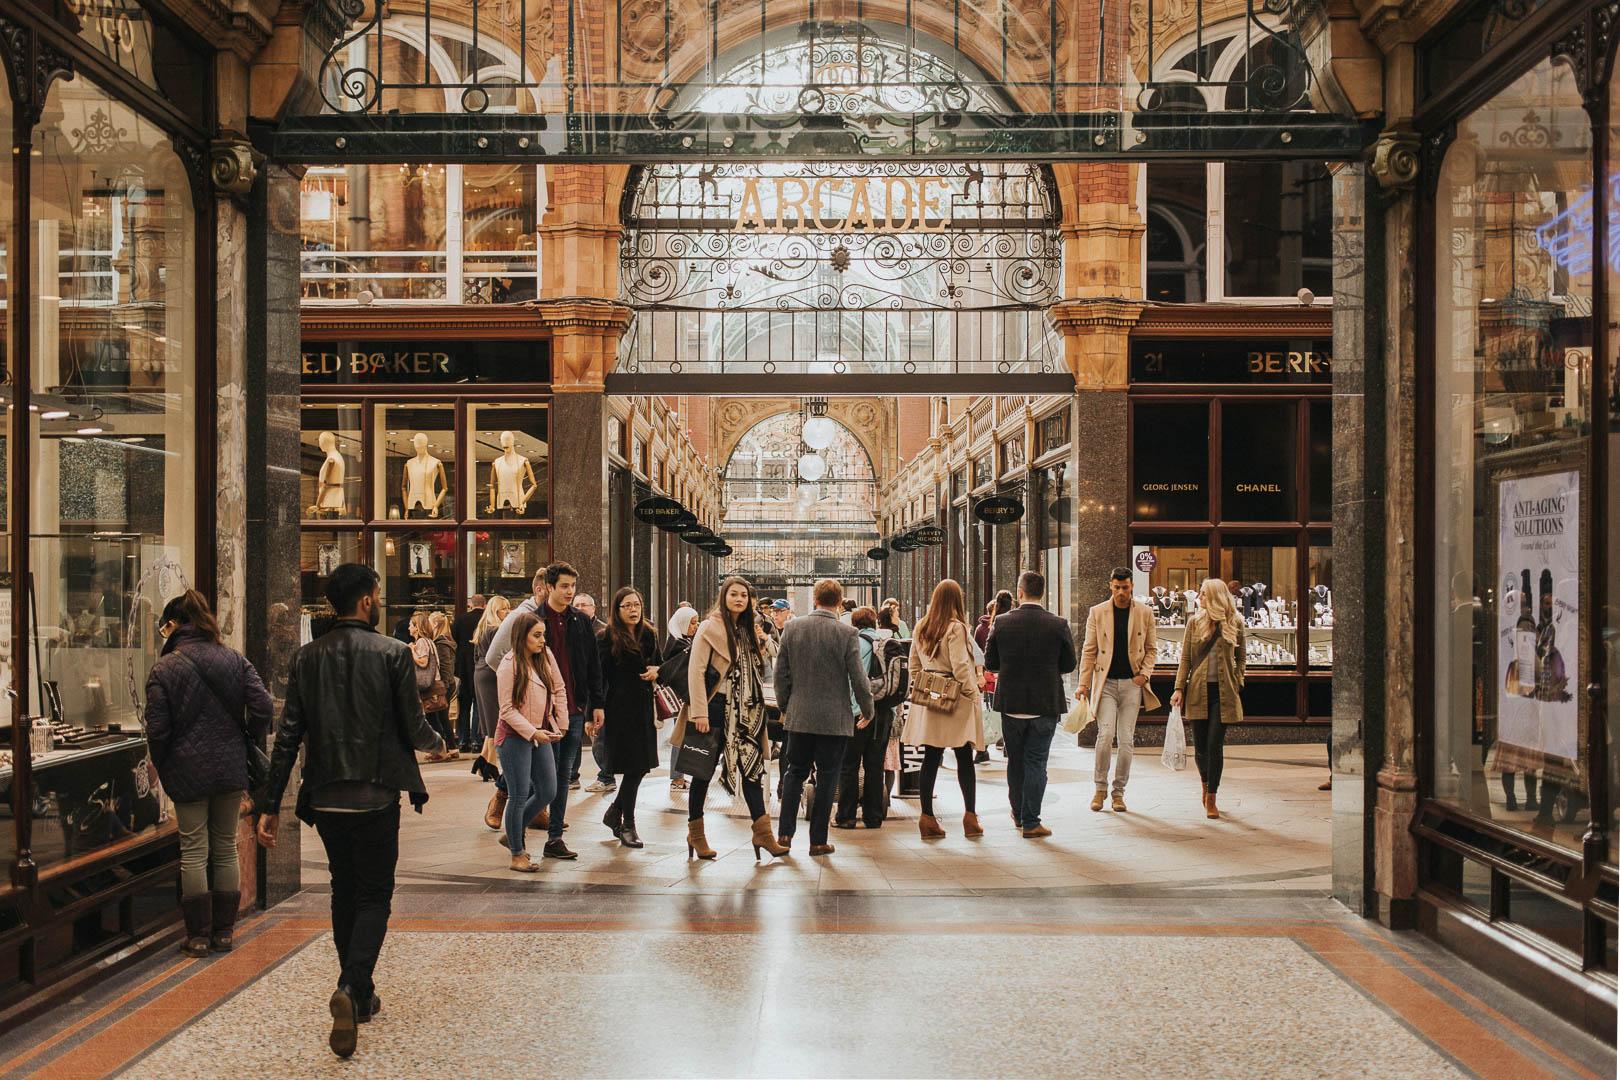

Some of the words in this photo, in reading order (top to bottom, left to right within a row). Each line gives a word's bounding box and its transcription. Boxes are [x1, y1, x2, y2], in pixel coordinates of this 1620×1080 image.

[732, 177, 951, 233] ARCADE
[301, 352, 341, 373] ED
[351, 352, 448, 373] BAKER
[1236, 484, 1281, 492] CHANEL
[1514, 497, 1566, 517] ANTI-AGING
[1514, 518, 1564, 536] SOLUTIONS
[1139, 552, 1153, 560] 0%
